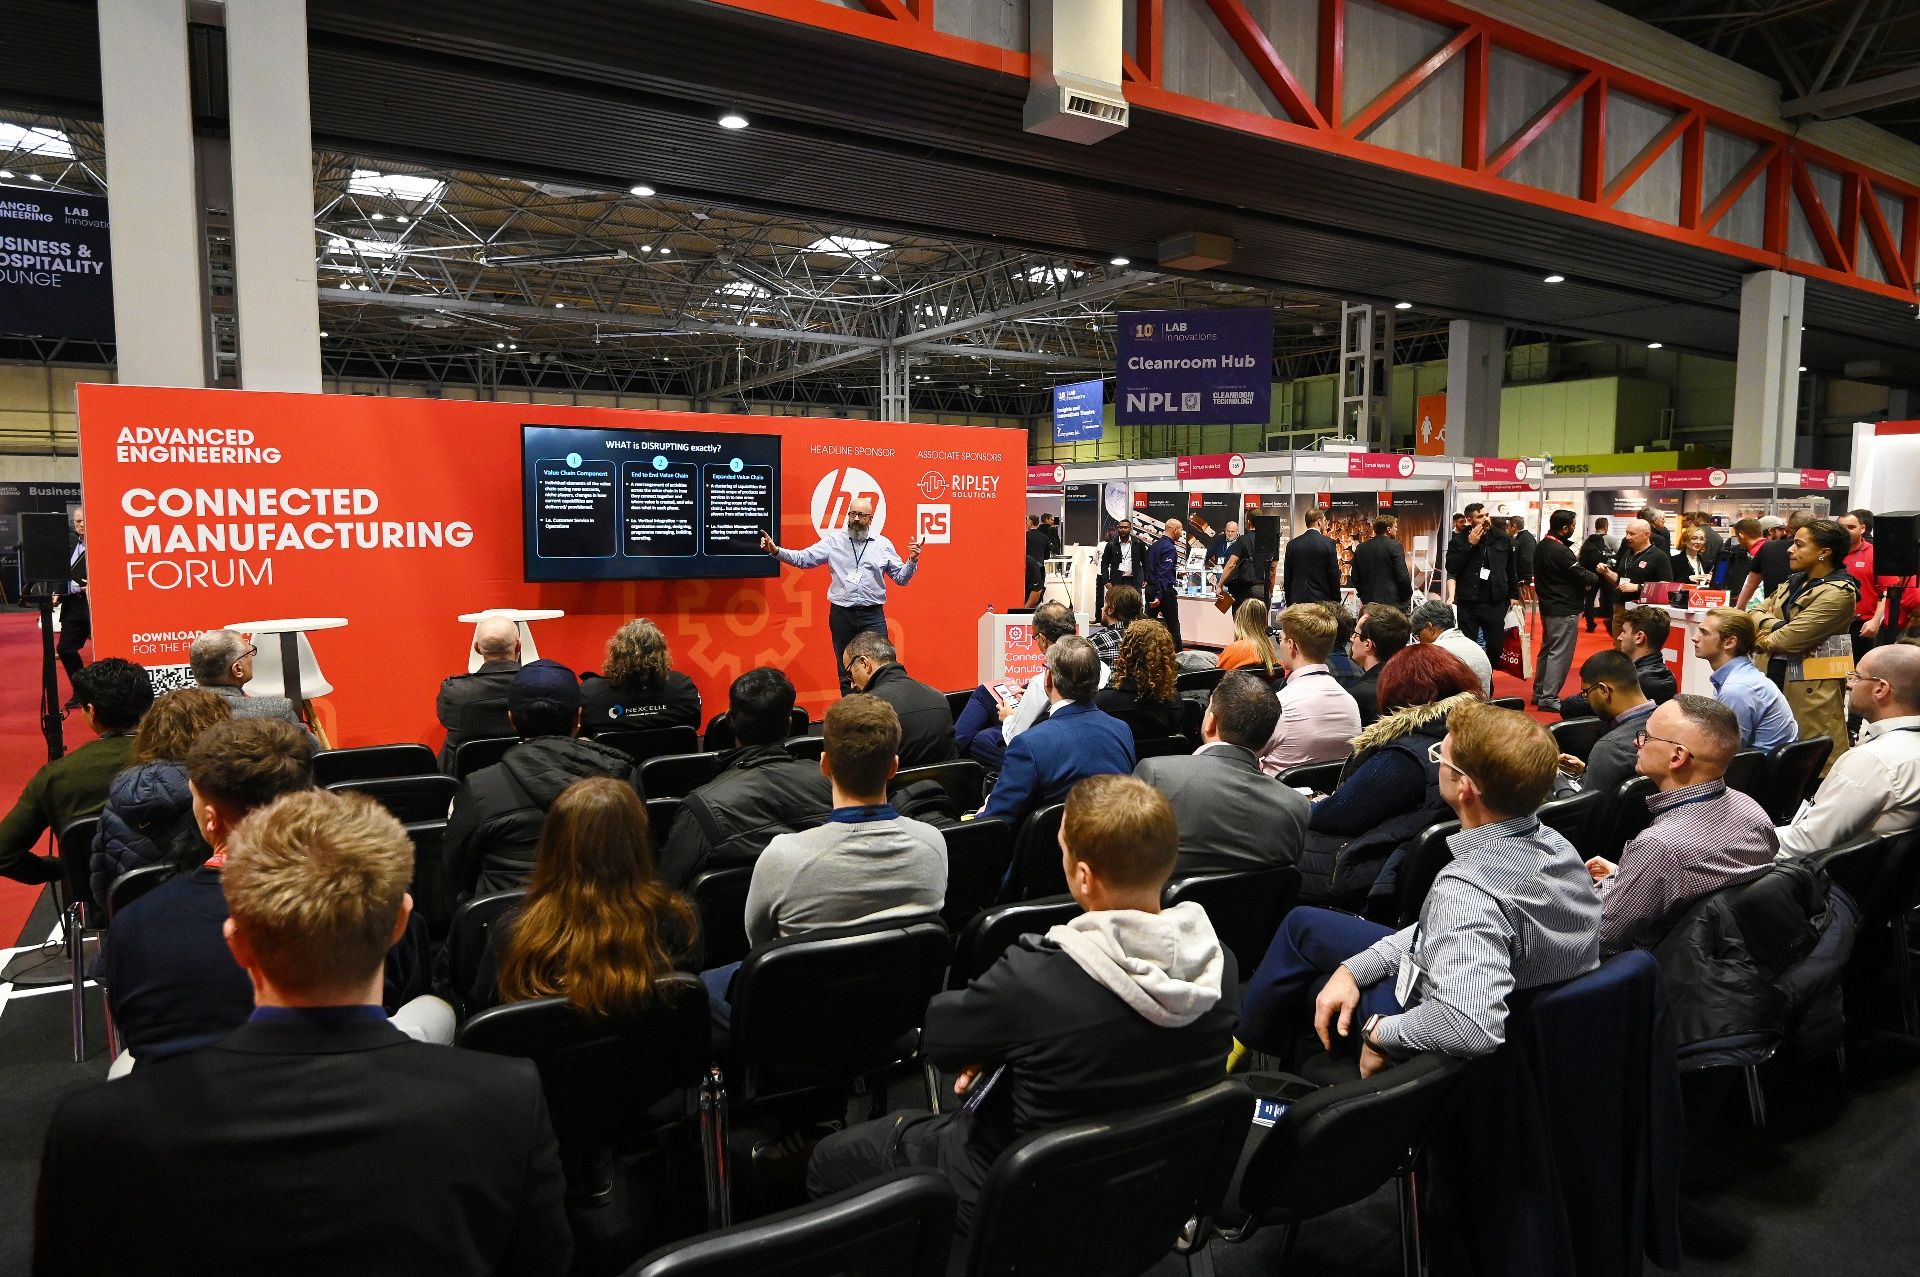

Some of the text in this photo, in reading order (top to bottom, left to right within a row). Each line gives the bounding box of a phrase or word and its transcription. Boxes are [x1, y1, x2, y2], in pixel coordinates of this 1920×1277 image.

[65, 207, 88, 216] LAB
[78, 245, 91, 257] &
[1136, 324, 1153, 337] 10
[1165, 323, 1187, 331] LAB
[1166, 333, 1217, 341] Innovations
[1128, 354, 1256, 370] Cleanroom Hub
[1126, 392, 1178, 412] NPL
[117, 427, 255, 446] ADVANCED
[606, 440, 722, 453] WHAT is DISRUPTING exactly?
[810, 445, 896, 457] HEADLINE SPONSOR
[116, 445, 282, 464] ENGINEERING
[918, 450, 1002, 462] ASSOCIATE SPONSORS
[952, 475, 1000, 492] RIPLEY
[121, 488, 380, 518] CONNECTED
[920, 512, 946, 535] RS
[123, 521, 474, 555] MANUFACTURING
[127, 558, 273, 590] FORUM
[133, 645, 157, 654] FOR
[160, 643, 179, 653] THE
[626, 704, 667, 713] NEXCELLE
